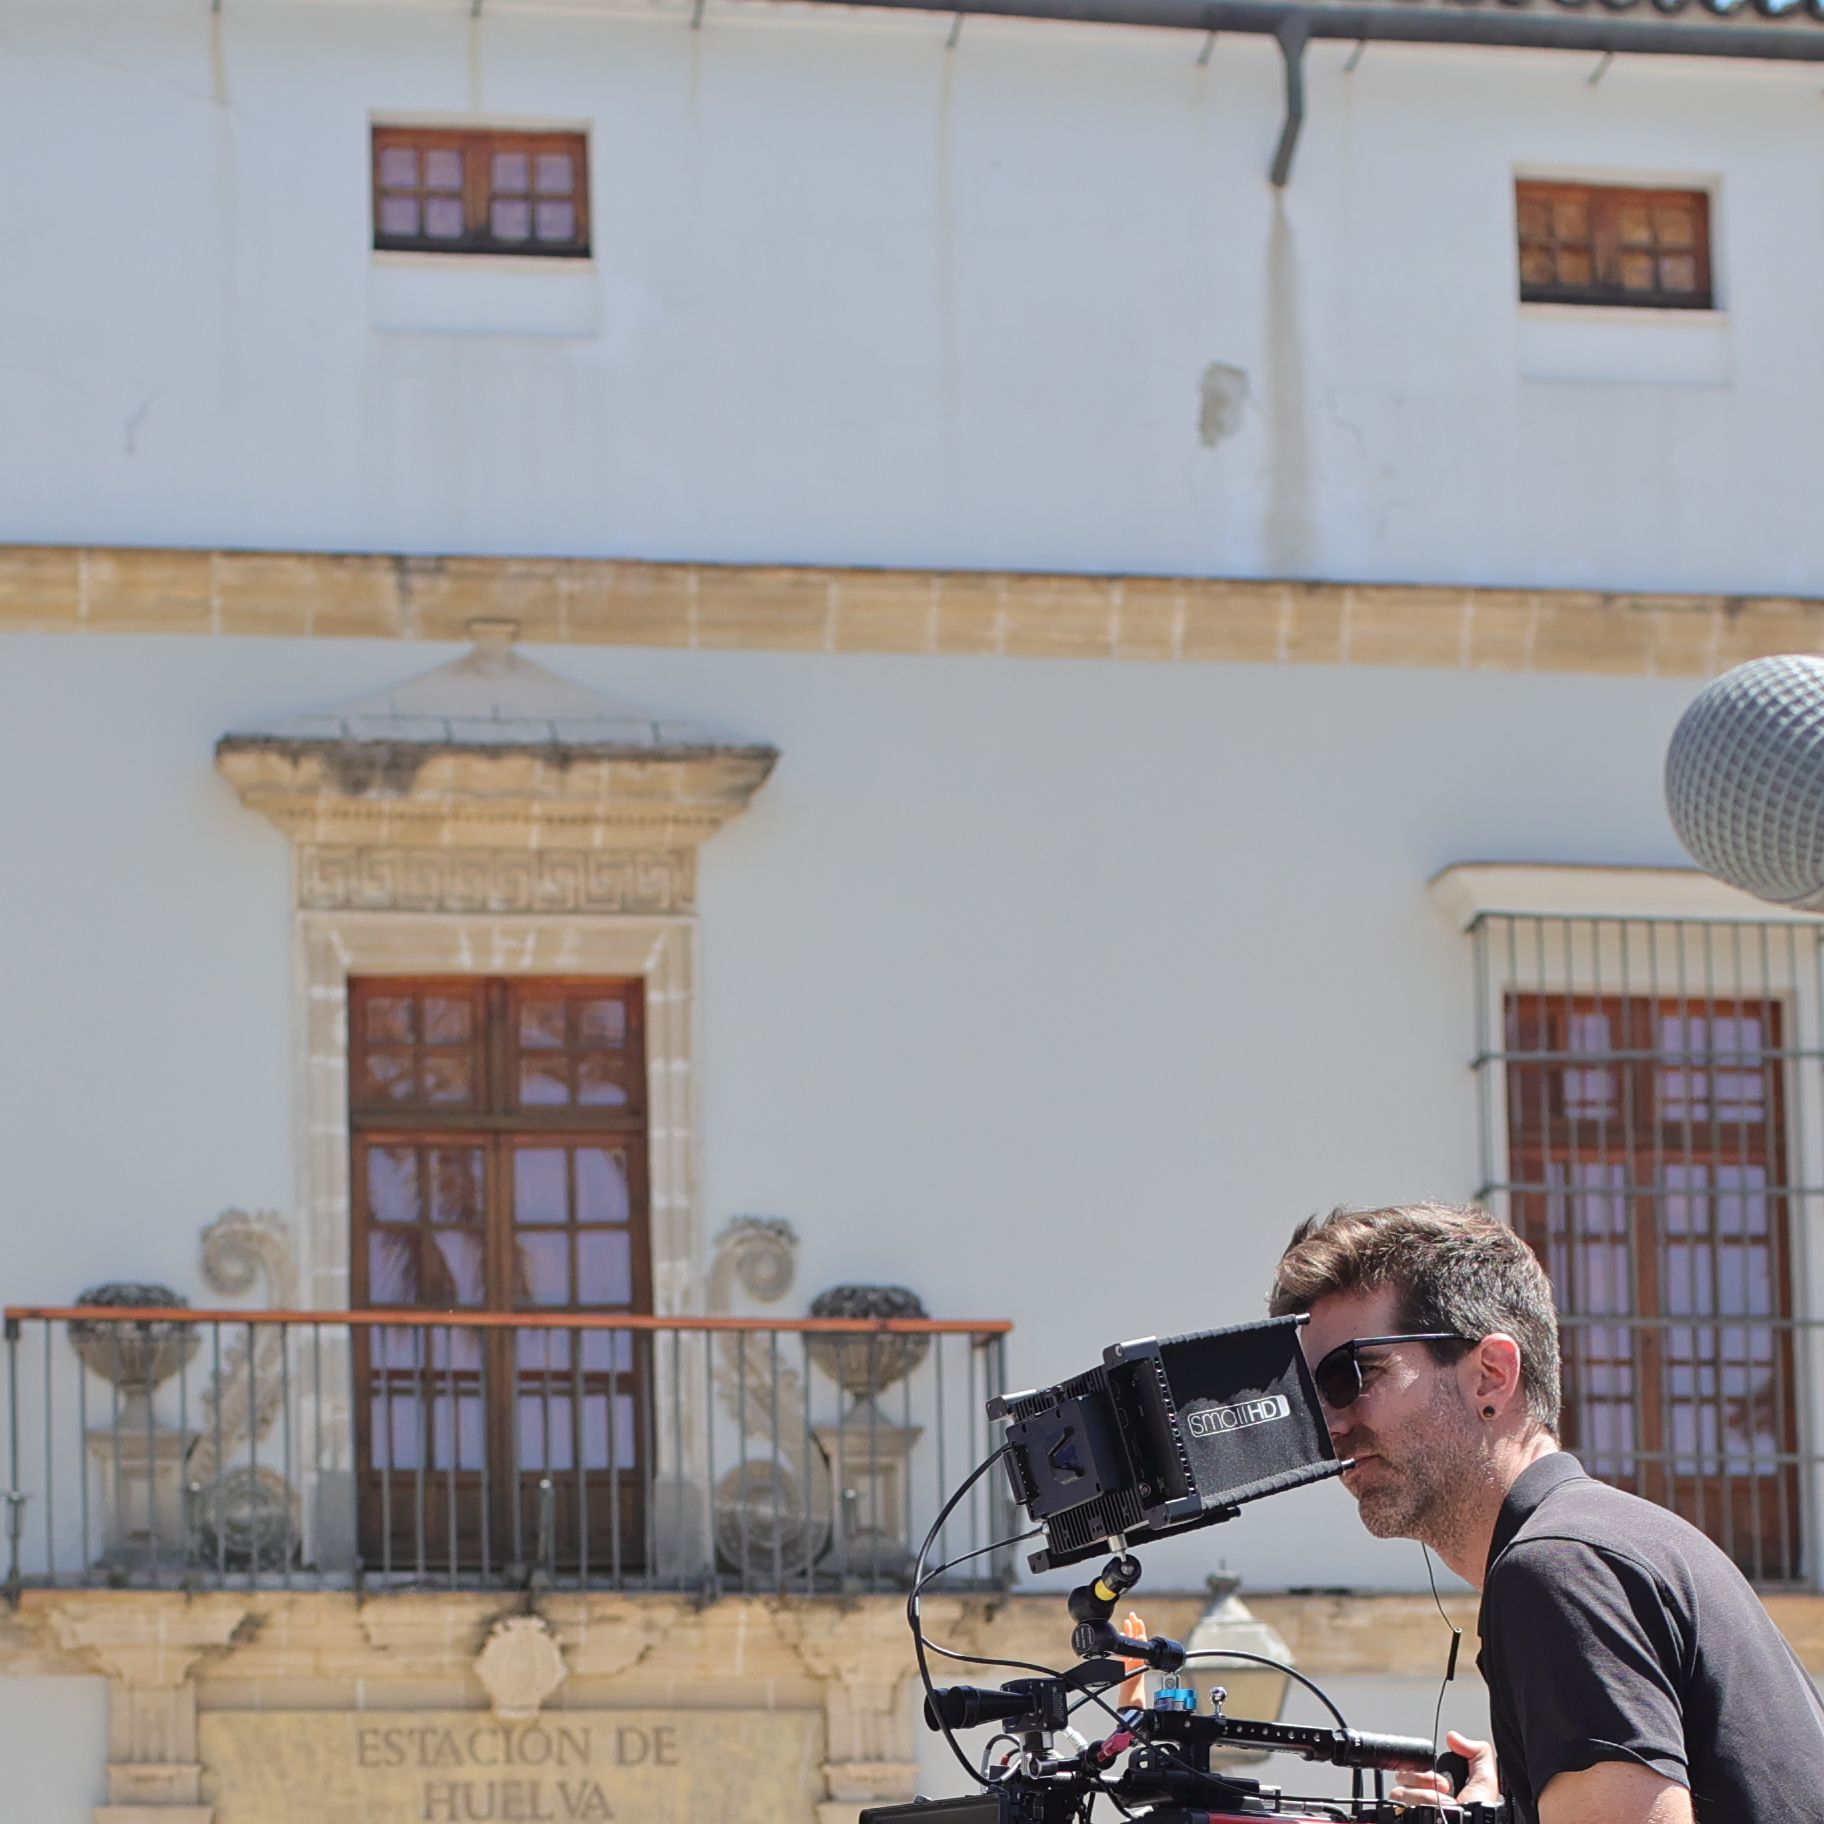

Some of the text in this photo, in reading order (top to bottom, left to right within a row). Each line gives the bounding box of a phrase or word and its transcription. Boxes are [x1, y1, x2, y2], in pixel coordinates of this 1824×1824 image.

[1190, 1400, 1277, 1434] smallHD
[356, 1720, 680, 1767] ESTACIÓN DE
[421, 1778, 615, 1822] HUELVA
